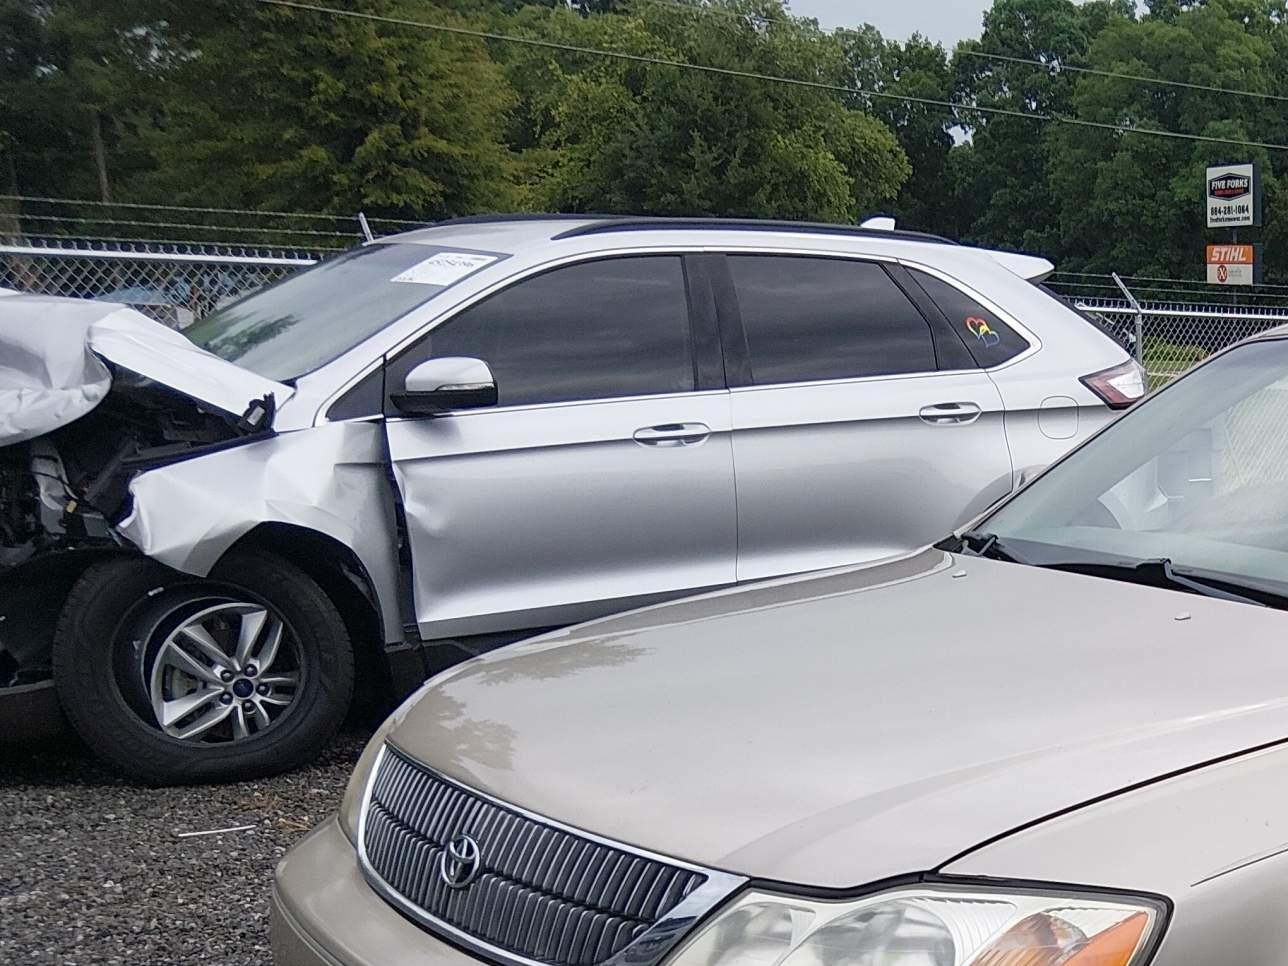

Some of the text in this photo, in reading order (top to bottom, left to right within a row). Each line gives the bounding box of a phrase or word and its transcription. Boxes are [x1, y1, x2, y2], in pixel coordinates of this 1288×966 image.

[1211, 178, 1248, 190] FIVE FORKS
[1211, 247, 1246, 261] STIHL
